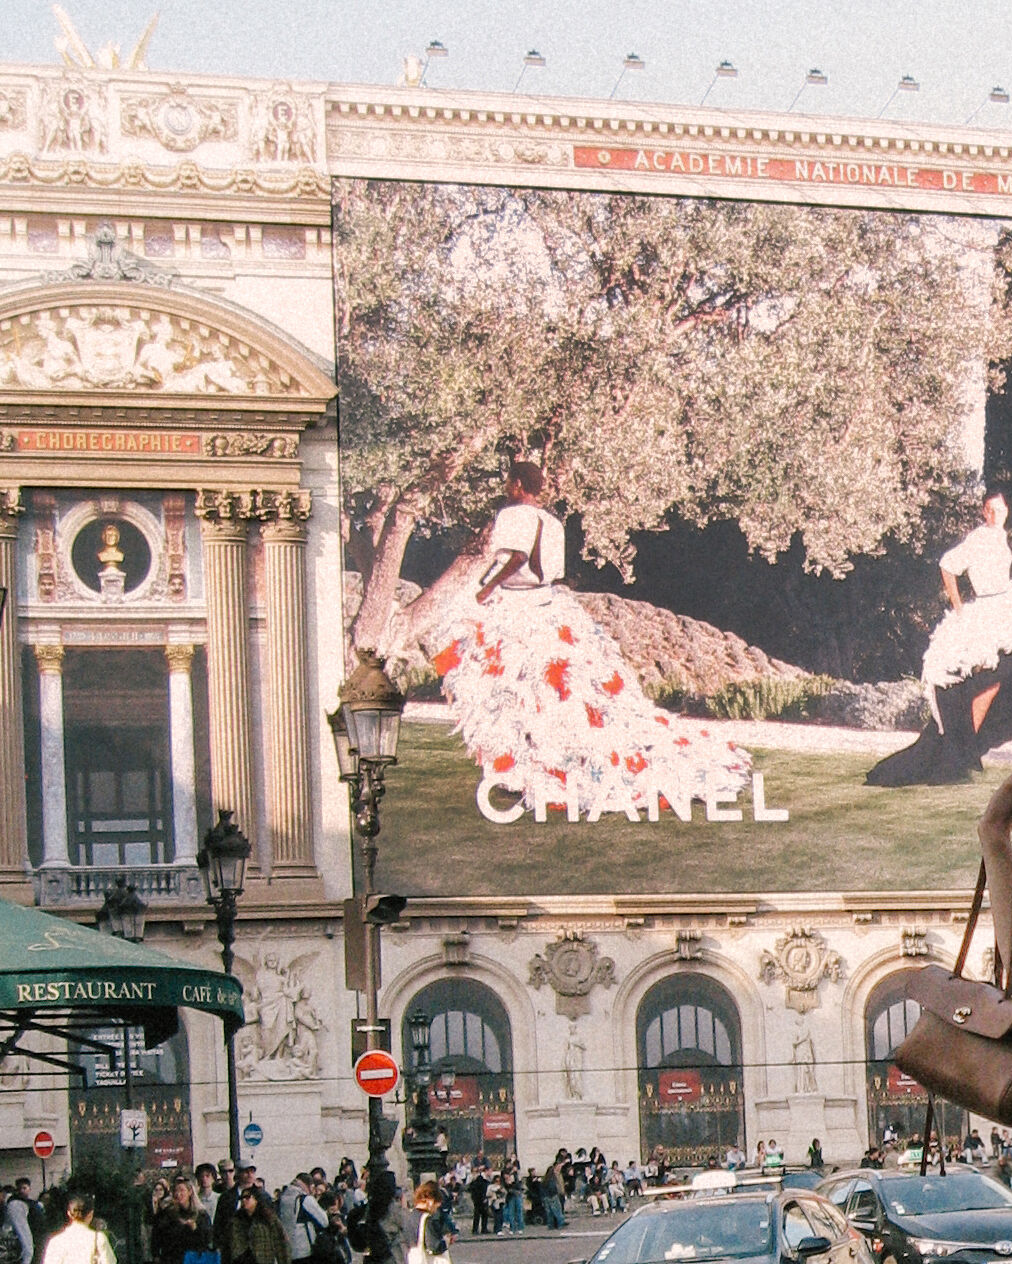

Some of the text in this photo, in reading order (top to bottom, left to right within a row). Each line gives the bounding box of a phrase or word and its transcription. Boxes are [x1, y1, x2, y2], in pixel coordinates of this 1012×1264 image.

[634, 150, 770, 177] ACADEMIE
[794, 160, 920, 187] NATIONALE
[942, 170, 975, 191] DE
[36, 432, 182, 451] CHOREGRAPHIE
[476, 773, 790, 825] CHANEL
[17, 981, 157, 1002] RESTAURANT
